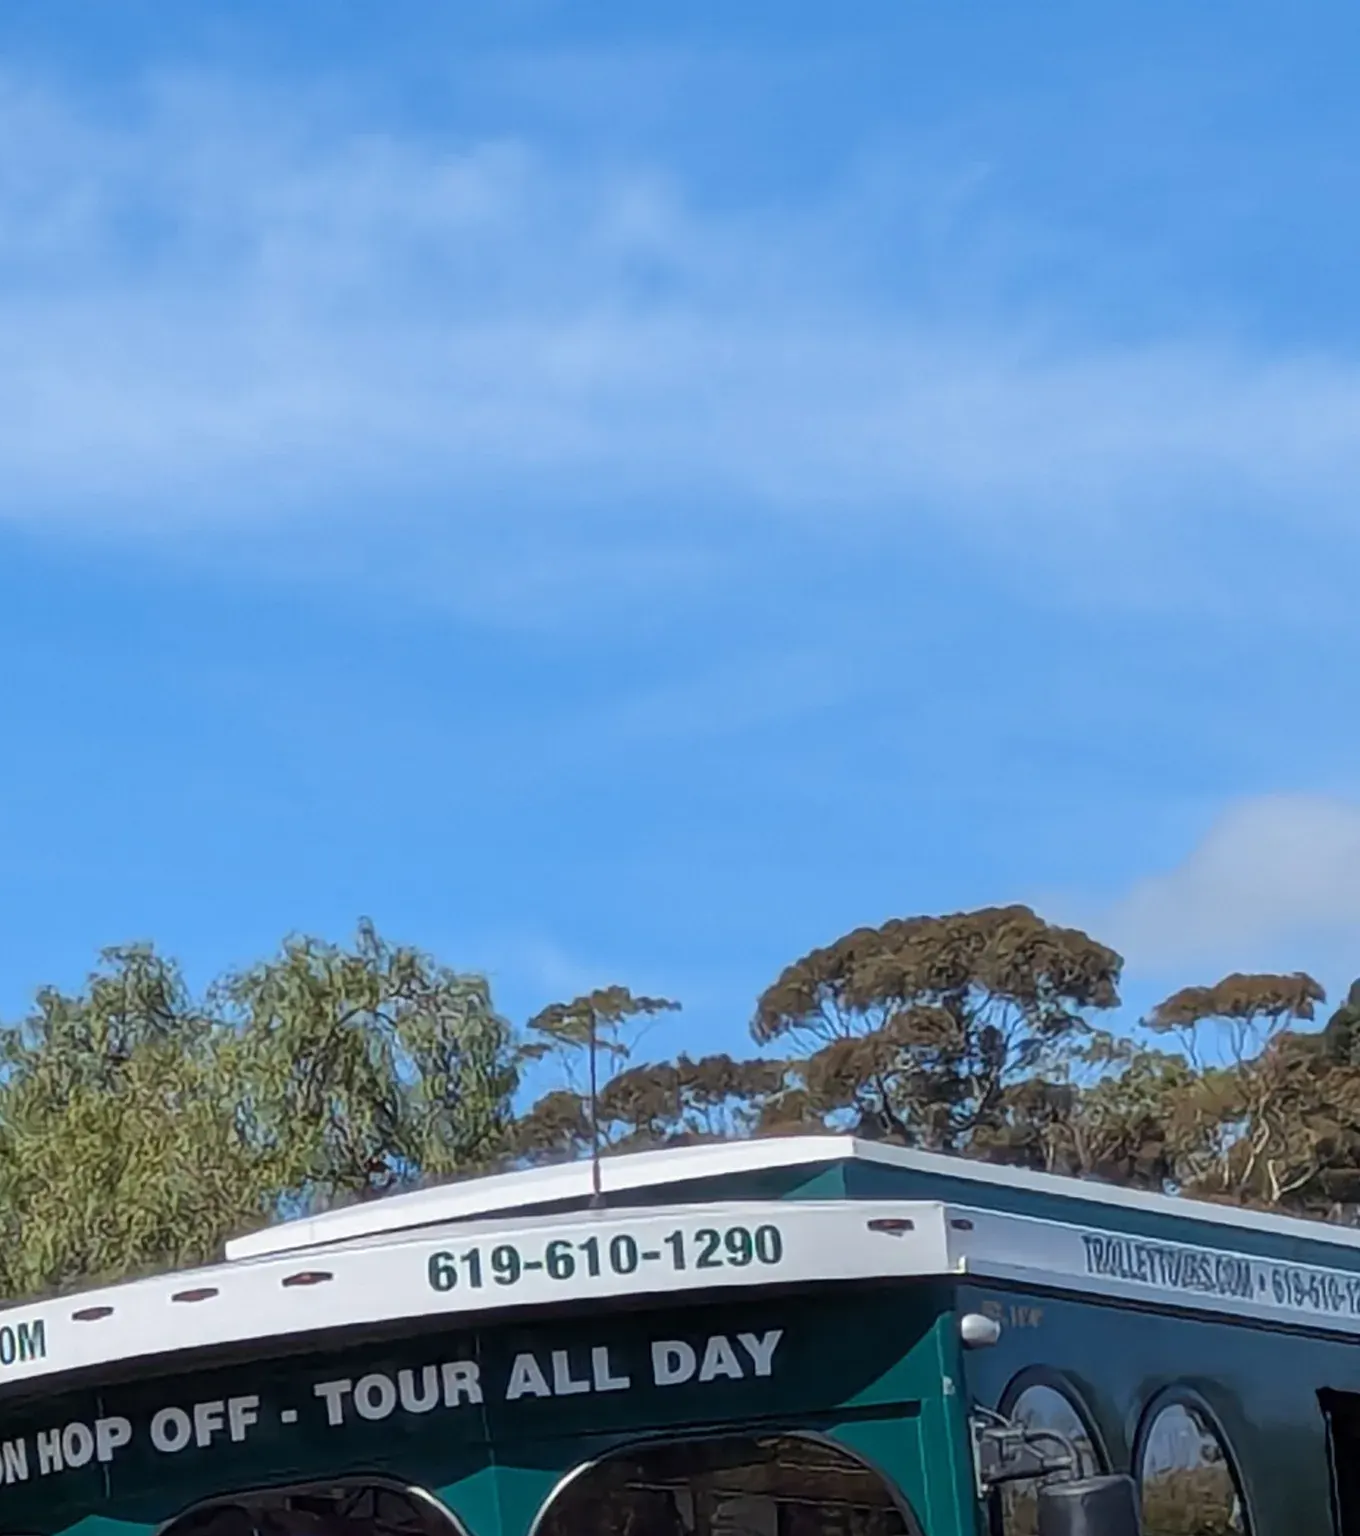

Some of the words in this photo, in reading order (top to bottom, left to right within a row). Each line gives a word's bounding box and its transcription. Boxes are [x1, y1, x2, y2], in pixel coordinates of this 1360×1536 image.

[428, 1225, 782, 1292] 619-610-1290
[37, 1416, 132, 1474] HOP
[150, 1395, 259, 1453] OFF
[315, 1360, 483, 1425] TOUR
[506, 1346, 630, 1400] ALL
[652, 1329, 783, 1387] DAY
